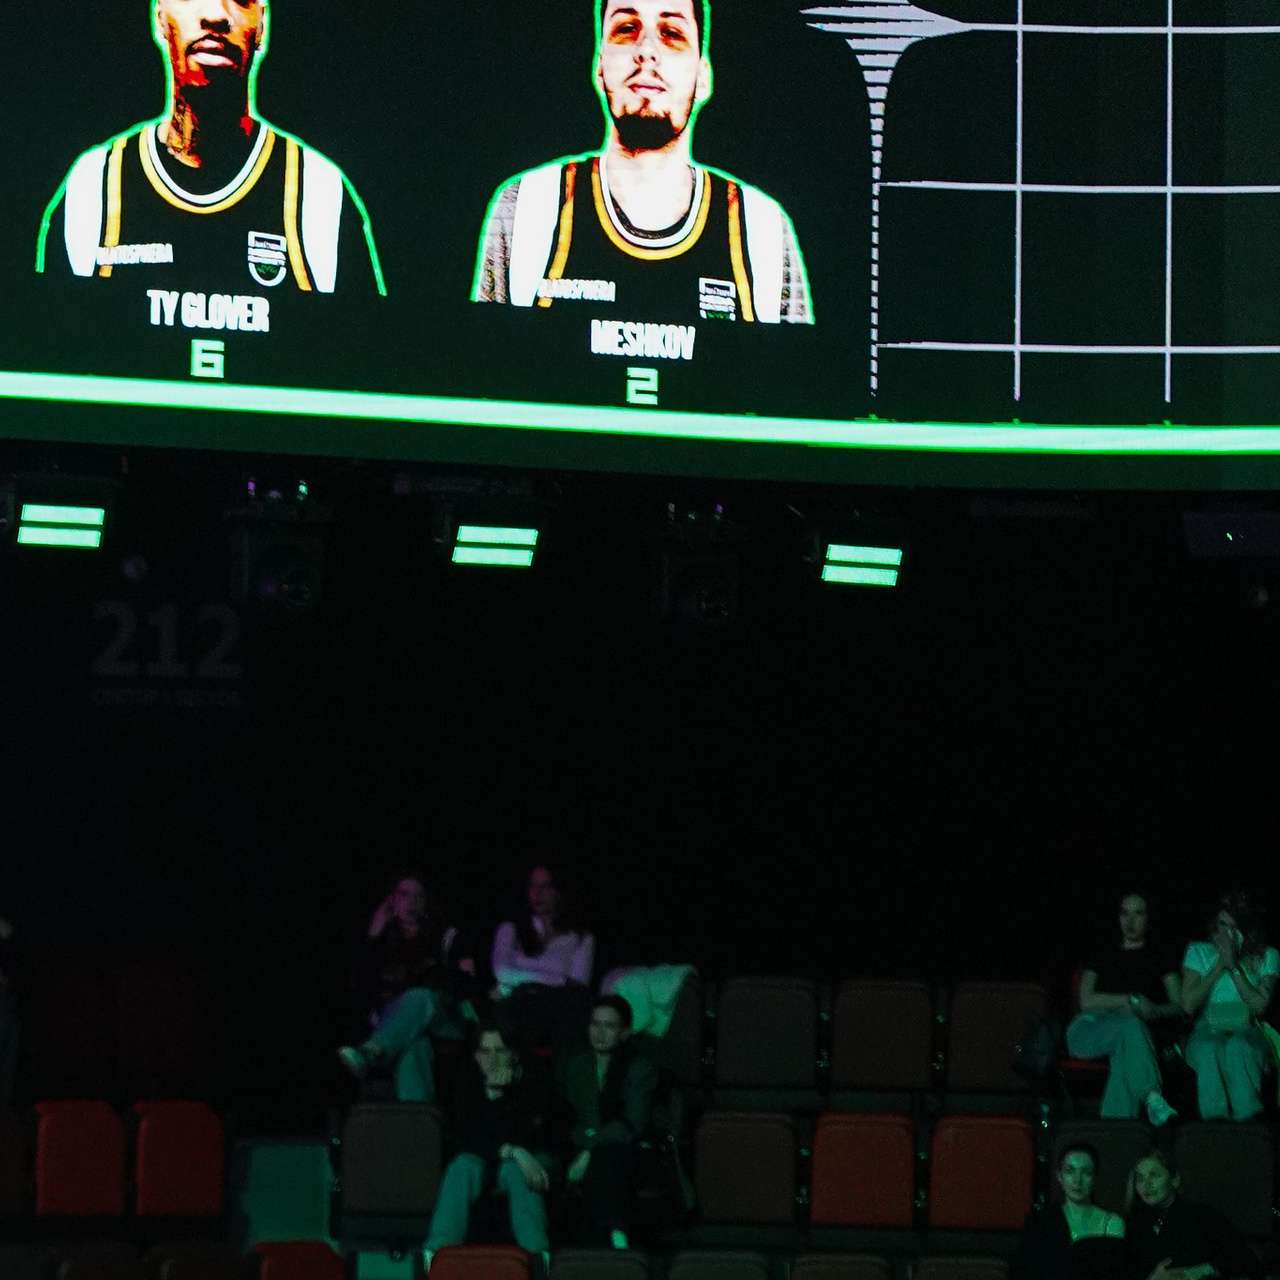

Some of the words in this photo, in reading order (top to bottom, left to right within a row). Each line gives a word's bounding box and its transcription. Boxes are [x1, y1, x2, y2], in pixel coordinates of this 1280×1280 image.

[147, 290, 179, 326] TY
[181, 292, 270, 332] GLOVER
[191, 339, 225, 378] 6
[591, 319, 696, 360] MESHKOV
[627, 367, 659, 405] 2
[90, 601, 243, 678] 212
